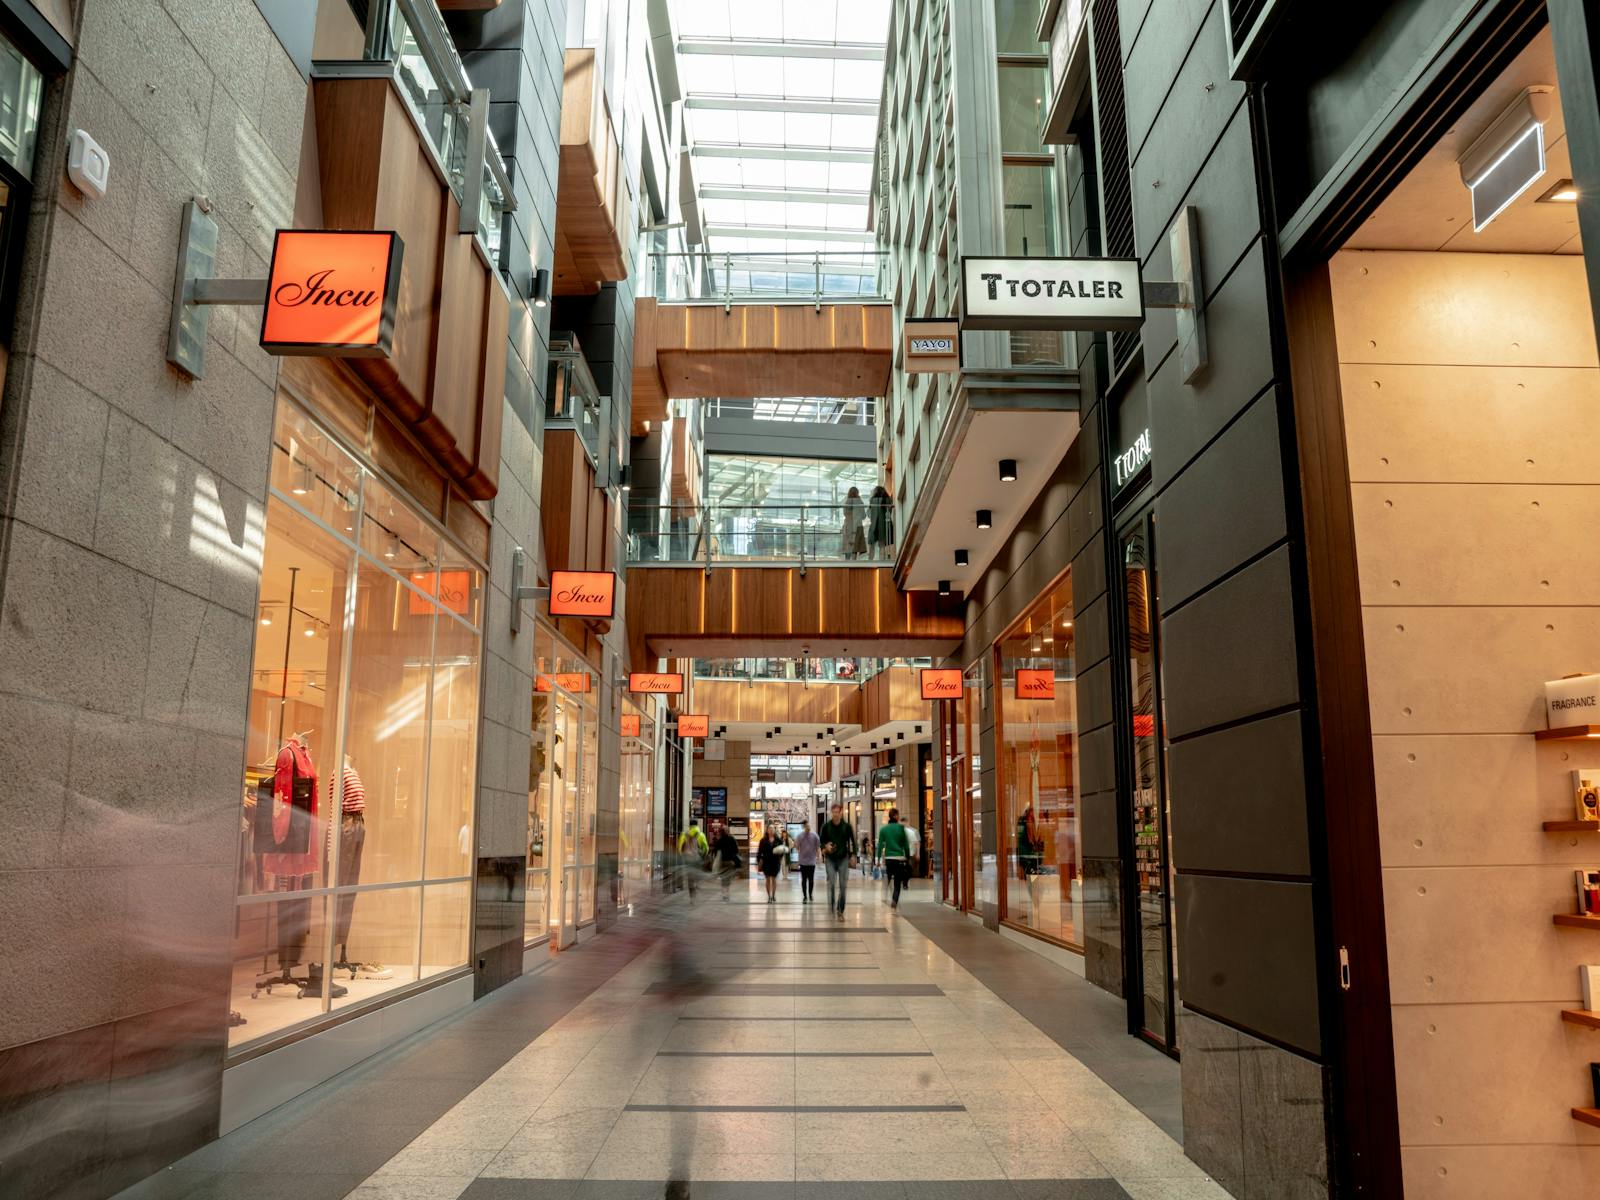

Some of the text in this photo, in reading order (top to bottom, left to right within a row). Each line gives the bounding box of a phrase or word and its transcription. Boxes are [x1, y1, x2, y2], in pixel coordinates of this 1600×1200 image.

[274, 269, 379, 307] Incu
[913, 340, 951, 348] YAYOI
[557, 585, 606, 603] Incu
[640, 676, 672, 689] Incu
[926, 678, 957, 691] Incu
[1551, 695, 1597, 711] FRAGRANCE
